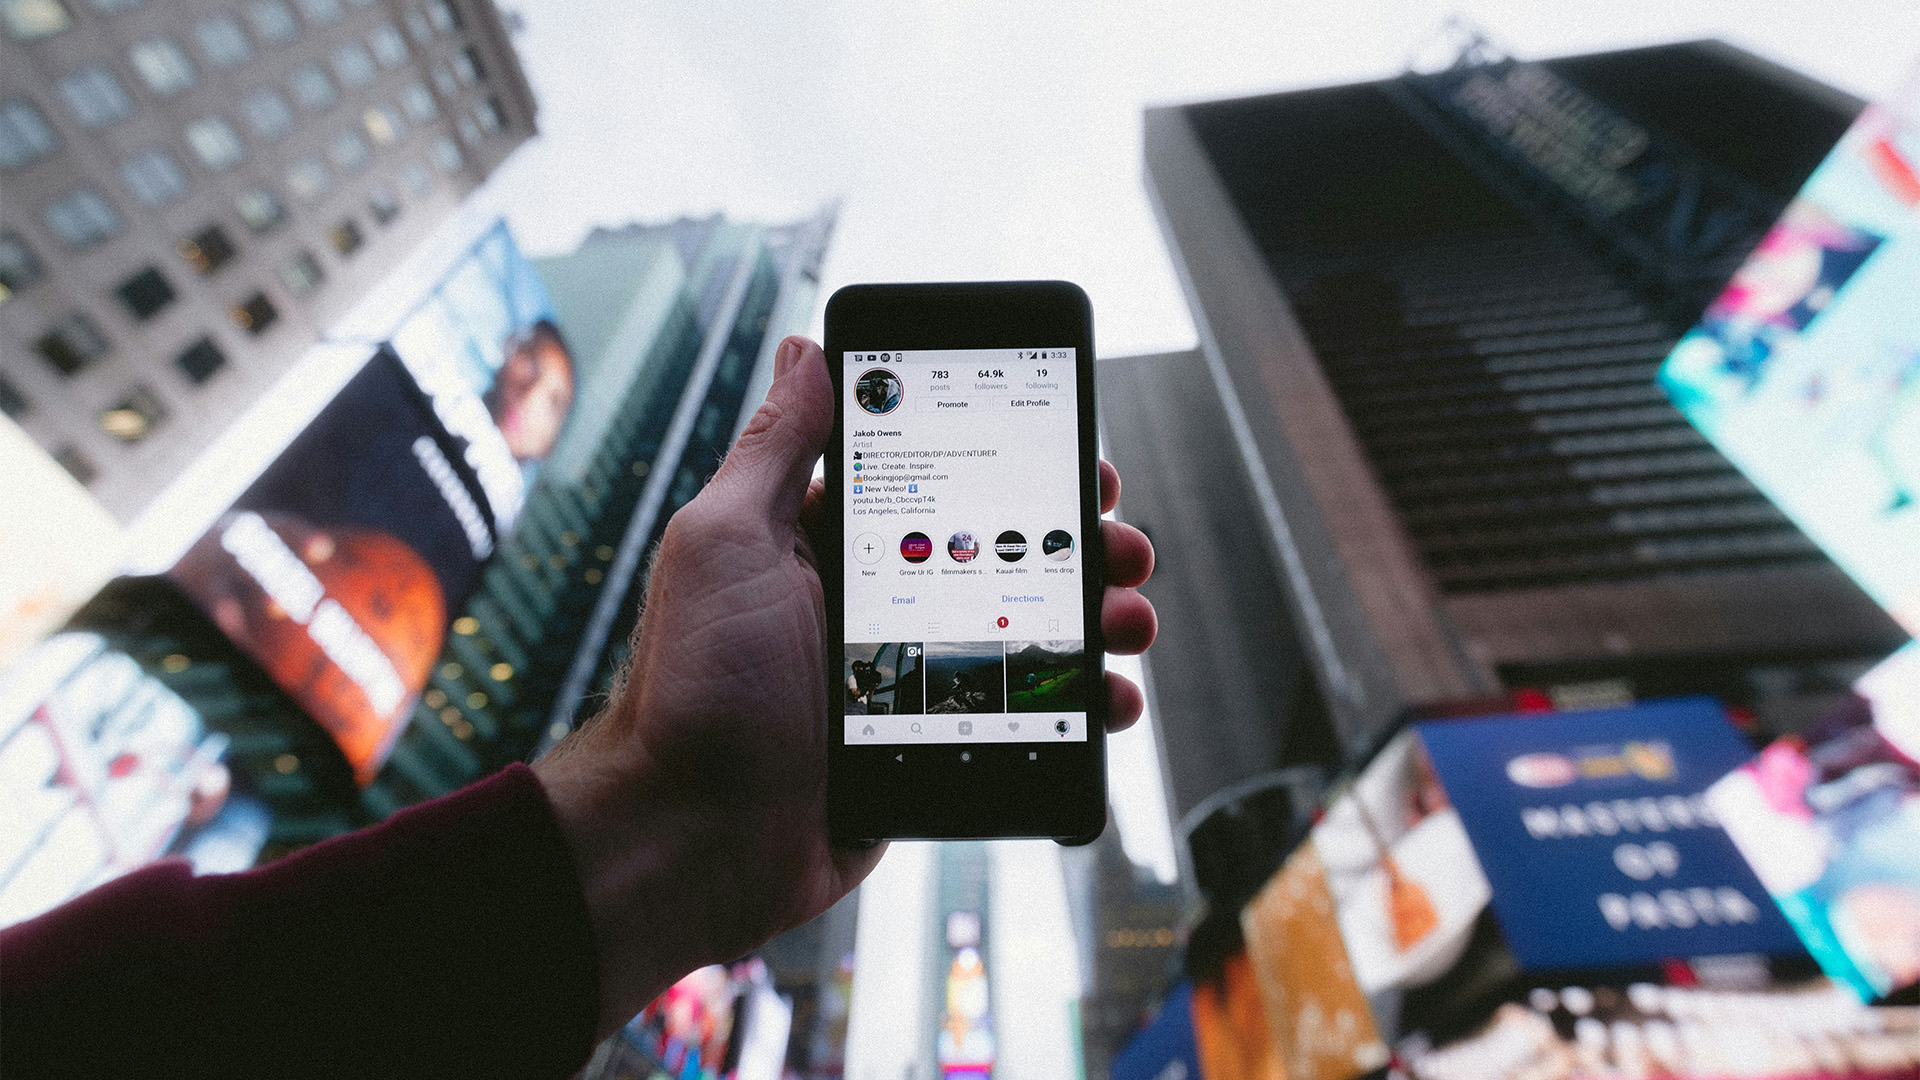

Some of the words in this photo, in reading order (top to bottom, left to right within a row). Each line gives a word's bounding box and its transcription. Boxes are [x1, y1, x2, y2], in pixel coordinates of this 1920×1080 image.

[1051, 351, 1067, 359] 3:33
[931, 370, 949, 379] 783
[977, 369, 1004, 379] 64.9k
[1036, 368, 1048, 378] 19
[930, 383, 950, 392] posts
[974, 382, 1008, 391] followers
[1025, 381, 1059, 390] following
[937, 400, 969, 409] Promote
[1010, 399, 1025, 407] Edit
[1026, 399, 1050, 407] Profile
[863, 450, 998, 459] DIRECTOR/EDITOR/DP/ADVENTURER
[863, 463, 880, 471] Live.
[909, 462, 936, 471] Inspire.
[863, 473, 949, 483] Bookingjop@gmail.com
[883, 485, 906, 493] Video!
[868, 508, 899, 516] Angeles,
[962, 534, 972, 542] 24
[1060, 567, 1075, 575] drop
[891, 596, 916, 605] Email
[1001, 595, 1045, 603] Directions
[1599, 887, 1759, 931] PASTA
